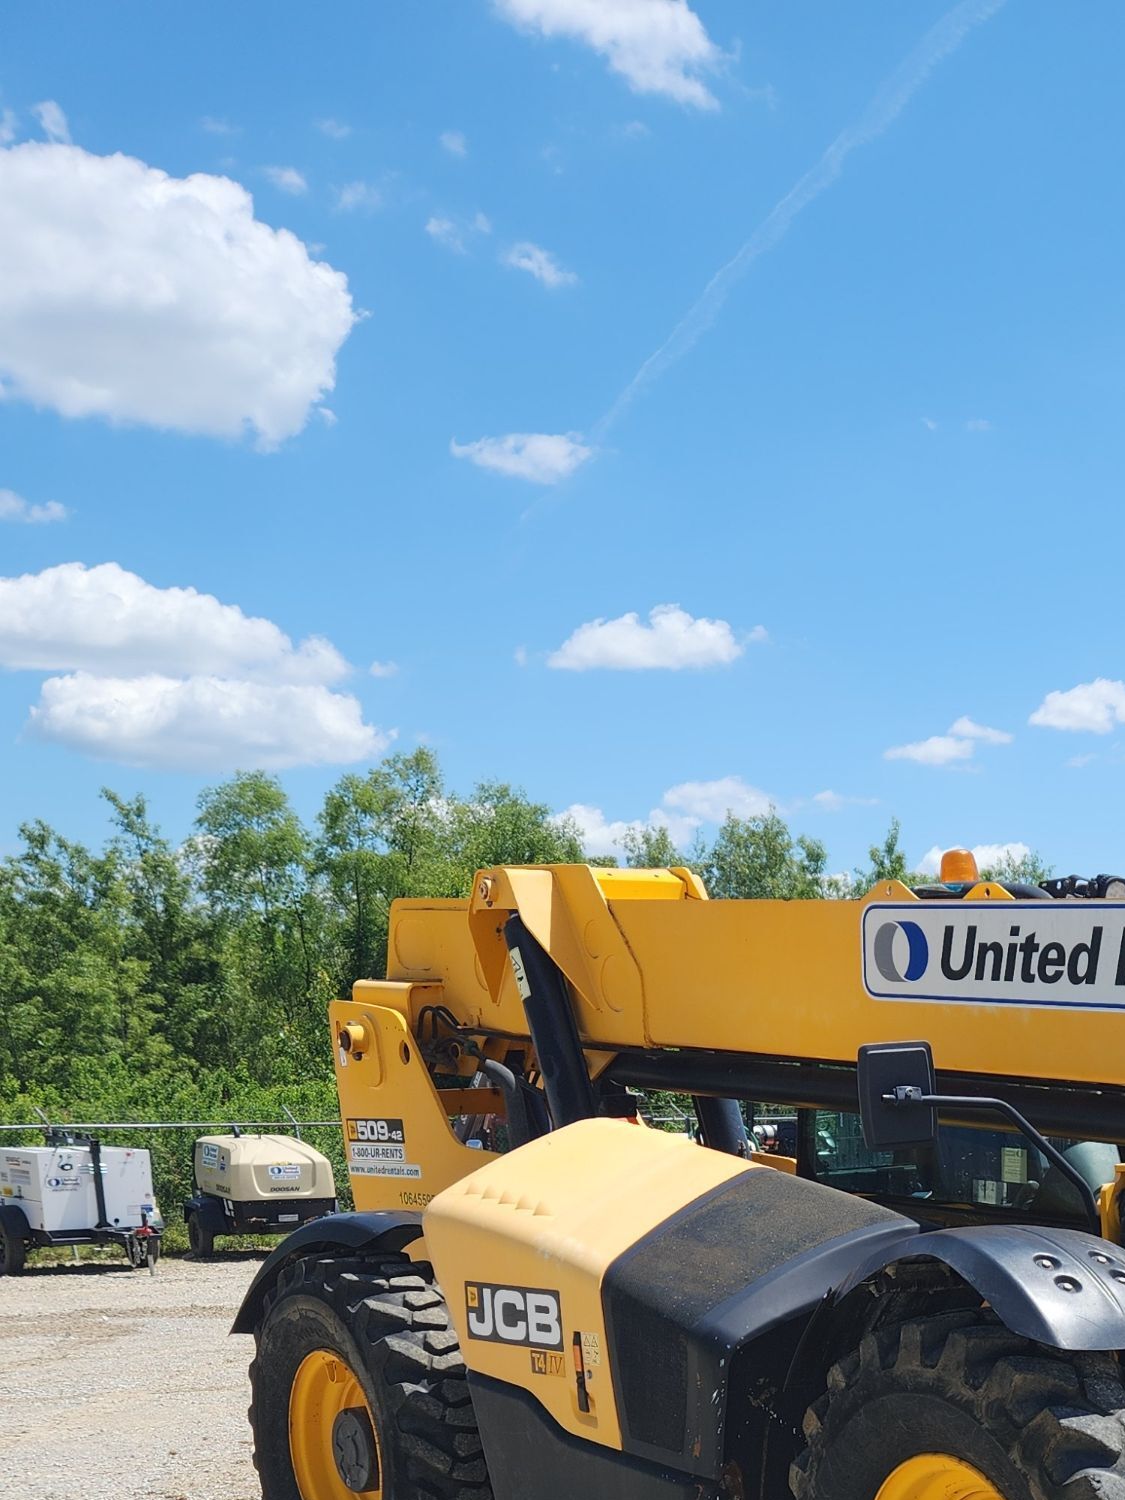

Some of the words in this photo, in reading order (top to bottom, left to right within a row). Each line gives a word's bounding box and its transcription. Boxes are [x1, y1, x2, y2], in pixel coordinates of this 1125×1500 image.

[940, 925, 1104, 985] United
[352, 1147, 403, 1159] 1-800-UR-RENTS
[351, 1165, 420, 1177] www.unitedrentals.com
[468, 1287, 561, 1346] JCB
